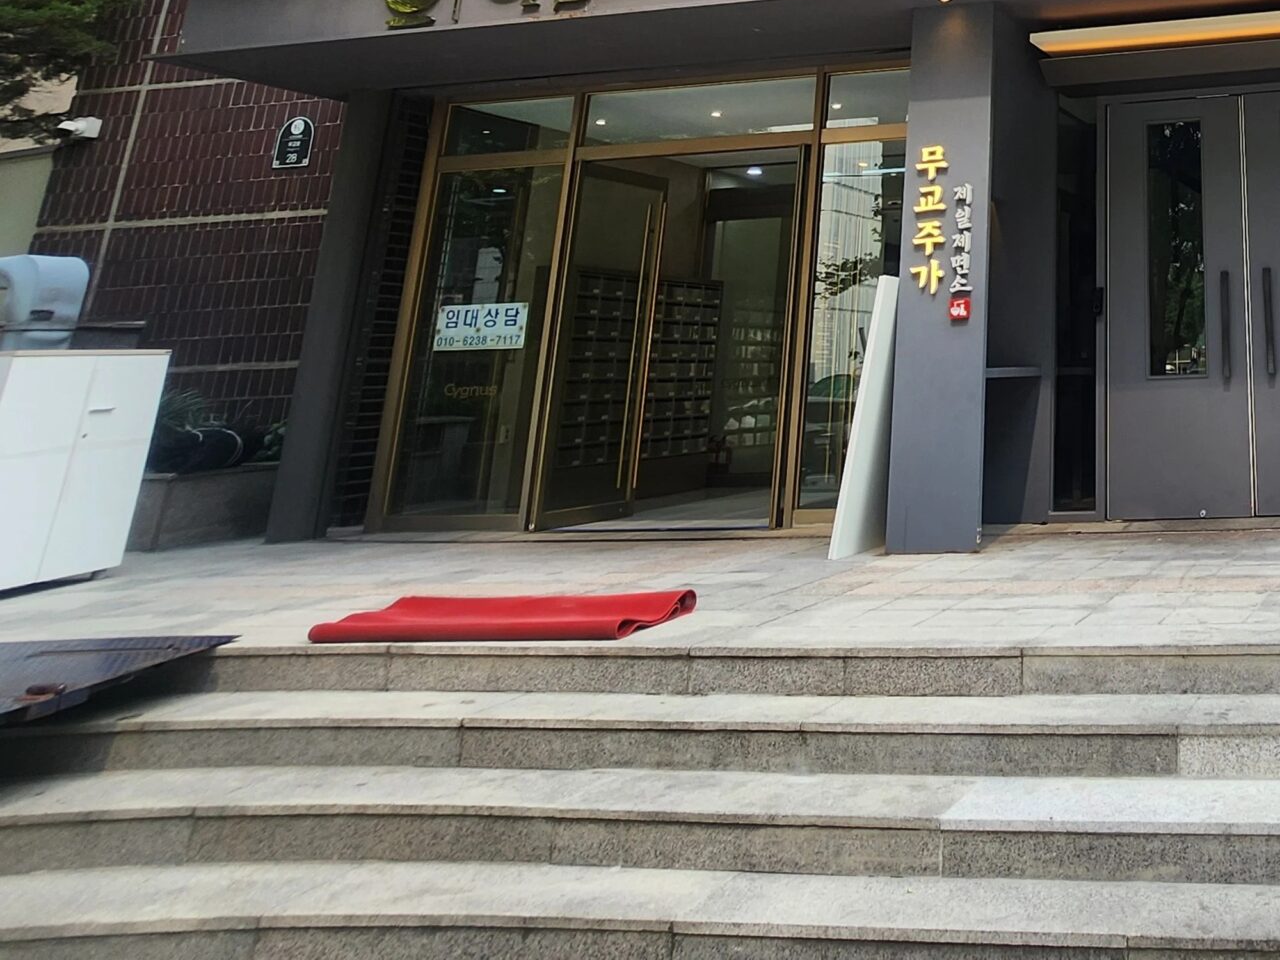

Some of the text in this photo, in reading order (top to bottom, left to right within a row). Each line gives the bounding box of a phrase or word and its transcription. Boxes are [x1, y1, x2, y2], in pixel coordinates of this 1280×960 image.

[909, 145, 949, 295] 무교주가
[949, 183, 974, 294] 제일제면소
[436, 334, 521, 347] 010-6238-7117
[443, 383, 498, 398] Cygnus
